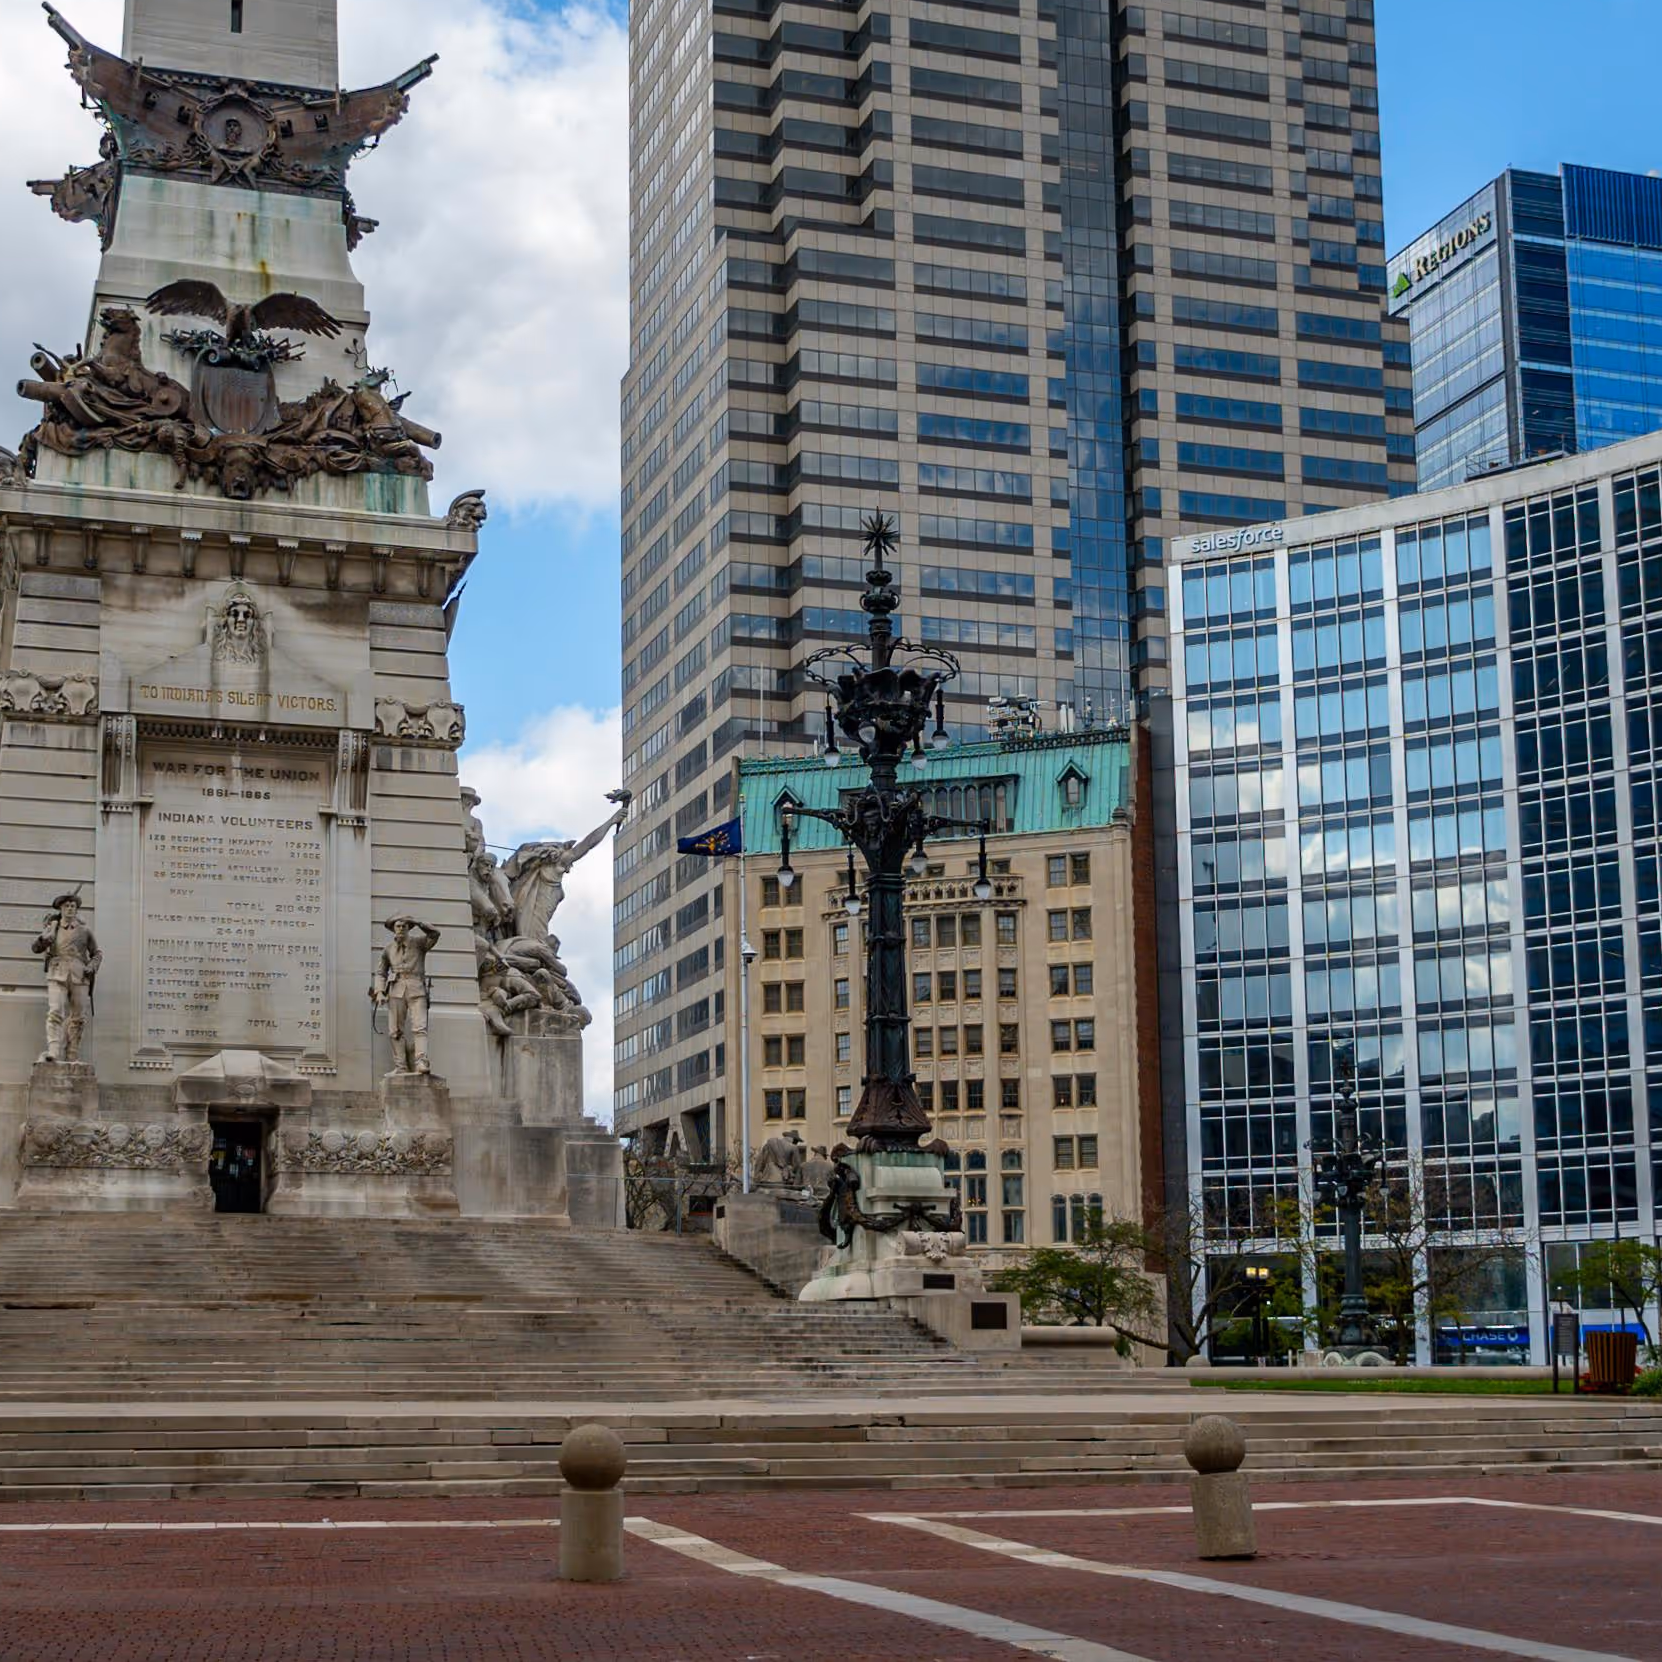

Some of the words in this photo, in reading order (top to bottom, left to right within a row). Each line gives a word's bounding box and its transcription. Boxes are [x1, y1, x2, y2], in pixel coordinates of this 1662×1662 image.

[1412, 211, 1492, 284] REGIONS
[1191, 525, 1283, 554] salesforce
[140, 685, 158, 699] TO
[228, 690, 273, 706] SILENT
[153, 761, 187, 774] WAR
[193, 764, 226, 777] FOR
[270, 769, 321, 782] UNION
[158, 812, 214, 825] INDIANA
[221, 816, 314, 831] VOLUNTEERS
[226, 901, 265, 911] TOTAL
[247, 1019, 278, 1028] TOTAL
[1462, 1331, 1506, 1341] CHASE
